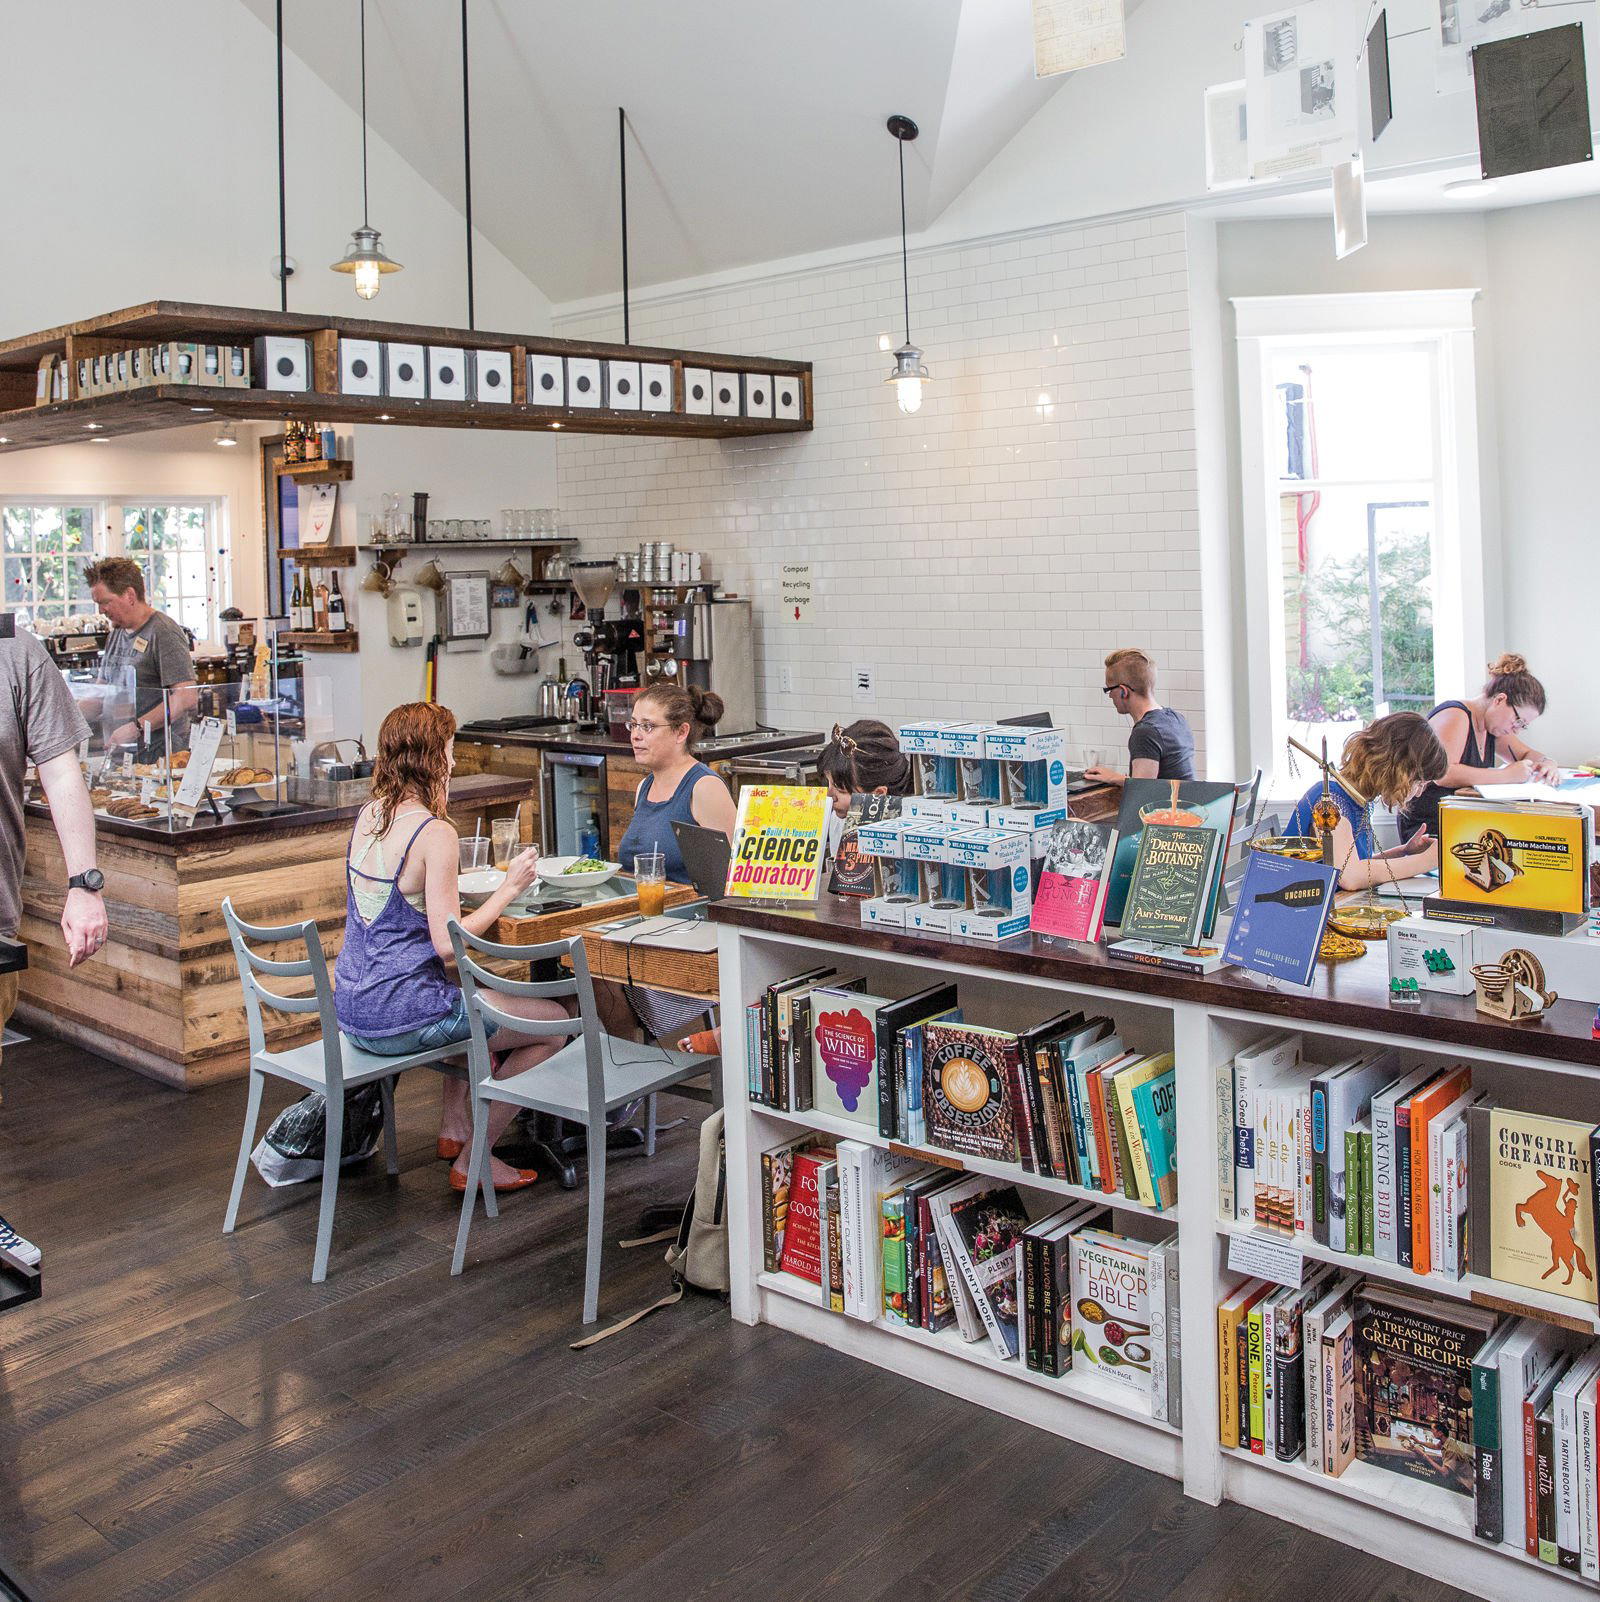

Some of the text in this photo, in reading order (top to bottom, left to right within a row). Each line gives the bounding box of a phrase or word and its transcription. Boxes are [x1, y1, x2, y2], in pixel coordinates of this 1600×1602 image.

[783, 565, 809, 573] Compost
[782, 581, 811, 590] Recycling
[783, 596, 810, 605] Garbage
[746, 788, 769, 797] ake:
[732, 828, 819, 863] Science
[766, 828, 817, 838] Build-It-Yourself
[1151, 838, 1203, 854] DRUNKEN
[1172, 832, 1186, 840] THE
[1530, 843, 1556, 851] Machine
[1146, 851, 1204, 870] BOTANIST
[1284, 888, 1320, 900] UNCORKED
[1134, 907, 1188, 923] AMY STEWART
[1134, 954, 1162, 965] PROOF
[824, 1036, 866, 1059] WINE
[825, 1029, 834, 1037] THE
[835, 1031, 856, 1041] SCIENCE
[878, 1046, 888, 1078] Death
[937, 1044, 992, 1072] COFFEE
[1022, 1048, 1030, 1067] FOOD
[1237, 1075, 1247, 1098] Italy's
[934, 1088, 1000, 1126] OBSESSION
[1238, 1099, 1248, 1127] Great
[952, 1134, 1004, 1150] 100 GLOBAL RECIPES
[1108, 1112, 1122, 1178] BOTTLE BAR
[1239, 1129, 1249, 1154] Chefs
[1303, 1108, 1312, 1160] SOUP CLUB
[1499, 1127, 1577, 1156] COWGIRL
[1132, 1139, 1142, 1170] WORDS
[1499, 1143, 1590, 1174] CREAMERY
[1499, 1160, 1522, 1170] COOKS
[1376, 1119, 1391, 1241] BAKING BIBLE
[1414, 1150, 1422, 1215] HOW TO BOIL EGG
[1445, 1187, 1454, 1214] Creamery
[792, 1222, 811, 1233] SCIENCE
[842, 1166, 852, 1265] MODERNIST CUISINE
[1347, 1203, 1356, 1236] Season
[1363, 1203, 1372, 1237] Season
[797, 1238, 806, 1246] THE
[829, 1216, 839, 1286] FLAVOR FLOURS
[1240, 1239, 1257, 1247] Cookbook
[1258, 1243, 1276, 1253] (America's
[1284, 1251, 1300, 1259] Kitchen)
[783, 1253, 812, 1269] HAROLD
[941, 1242, 961, 1308] OTTOLENGHI
[987, 1255, 1014, 1274] PLENTY
[1027, 1252, 1035, 1286] FLAVOR
[1043, 1256, 1051, 1290] FLAVOR
[1082, 1248, 1146, 1277] VEGETARIAN
[1078, 1259, 1148, 1296] FLAVOR
[959, 1255, 995, 1329] PLENTY MORE
[1088, 1280, 1138, 1312] BIBLE
[1151, 1311, 1164, 1342] COI
[1368, 1307, 1466, 1342] MARY VINCENT PRICE
[1507, 1303, 1556, 1324] Cookbooks
[1362, 1327, 1472, 1371] GREAT RECIPES
[1372, 1318, 1461, 1352] A TREASURY OF
[1098, 1363, 1132, 1381] KAREN PAGE
[1249, 1322, 1260, 1404] DONE. Peterson
[1325, 1364, 1334, 1396] Cooking
[1309, 1358, 1319, 1448] The Real Food Cookbook
[1326, 1397, 1334, 1408] for
[1404, 1462, 1436, 1475] ANNIVERSARY
[1482, 1453, 1493, 1480] Relæ
[1561, 1438, 1570, 1495] TARTINE BOOK
[1583, 1437, 1591, 1472] DELANCEY
[1410, 1467, 1431, 1477] EDITION
[1538, 1454, 1554, 1495] miette
